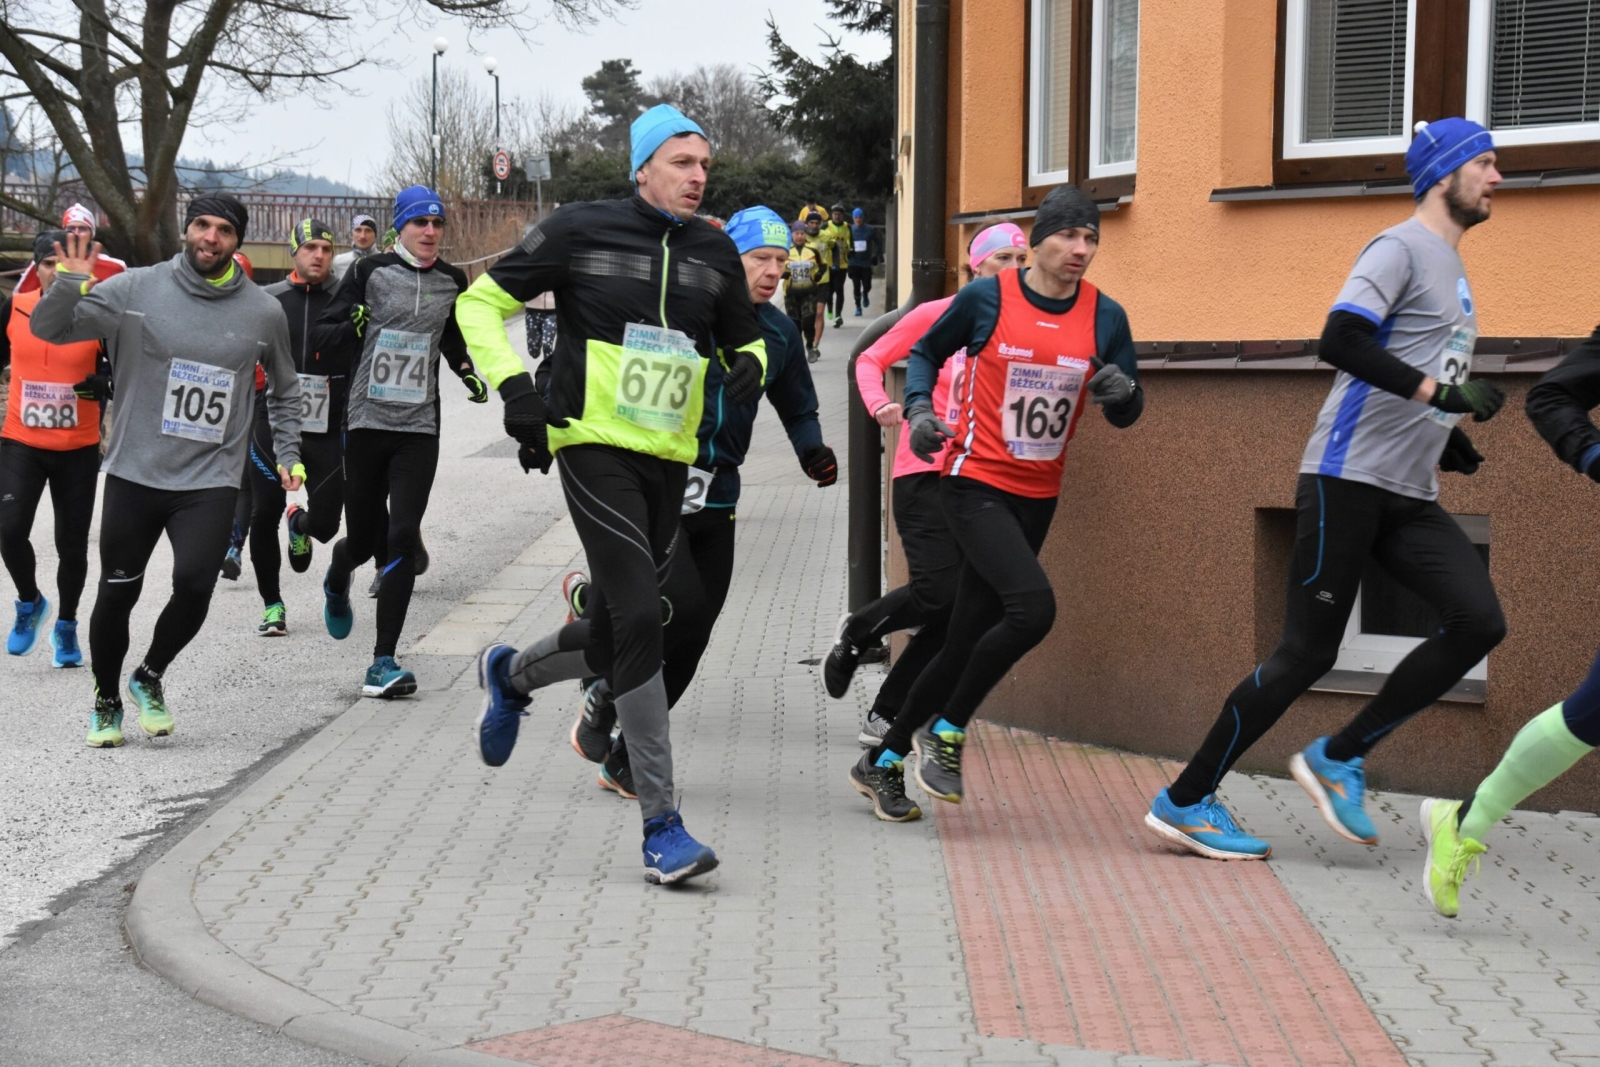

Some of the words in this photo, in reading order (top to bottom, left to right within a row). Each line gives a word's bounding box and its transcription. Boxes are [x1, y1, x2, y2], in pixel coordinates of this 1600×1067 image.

[792, 267, 810, 280] 642
[628, 328, 662, 342] ZIMNÍ
[411, 343, 429, 351] LIGA
[625, 340, 673, 356] BĚŽECKÁ
[677, 348, 699, 361] LIGA
[173, 362, 201, 374] ZIMNÍ
[373, 352, 426, 388] 674
[1011, 367, 1044, 377] ZIMNÍ
[171, 370, 209, 385] BĚŽECKÁ
[212, 378, 230, 388] LIGA
[621, 357, 693, 410] 673
[1009, 378, 1054, 391] BĚŽECKÁ
[1058, 382, 1080, 392] LIGA
[24, 383, 47, 392] ZIMNÍ
[24, 391, 57, 400] BĚŽECKÁ
[59, 393, 76, 401] LIGA
[171, 384, 227, 426] 105
[23, 402, 76, 429] 638
[1009, 395, 1071, 440] 163
